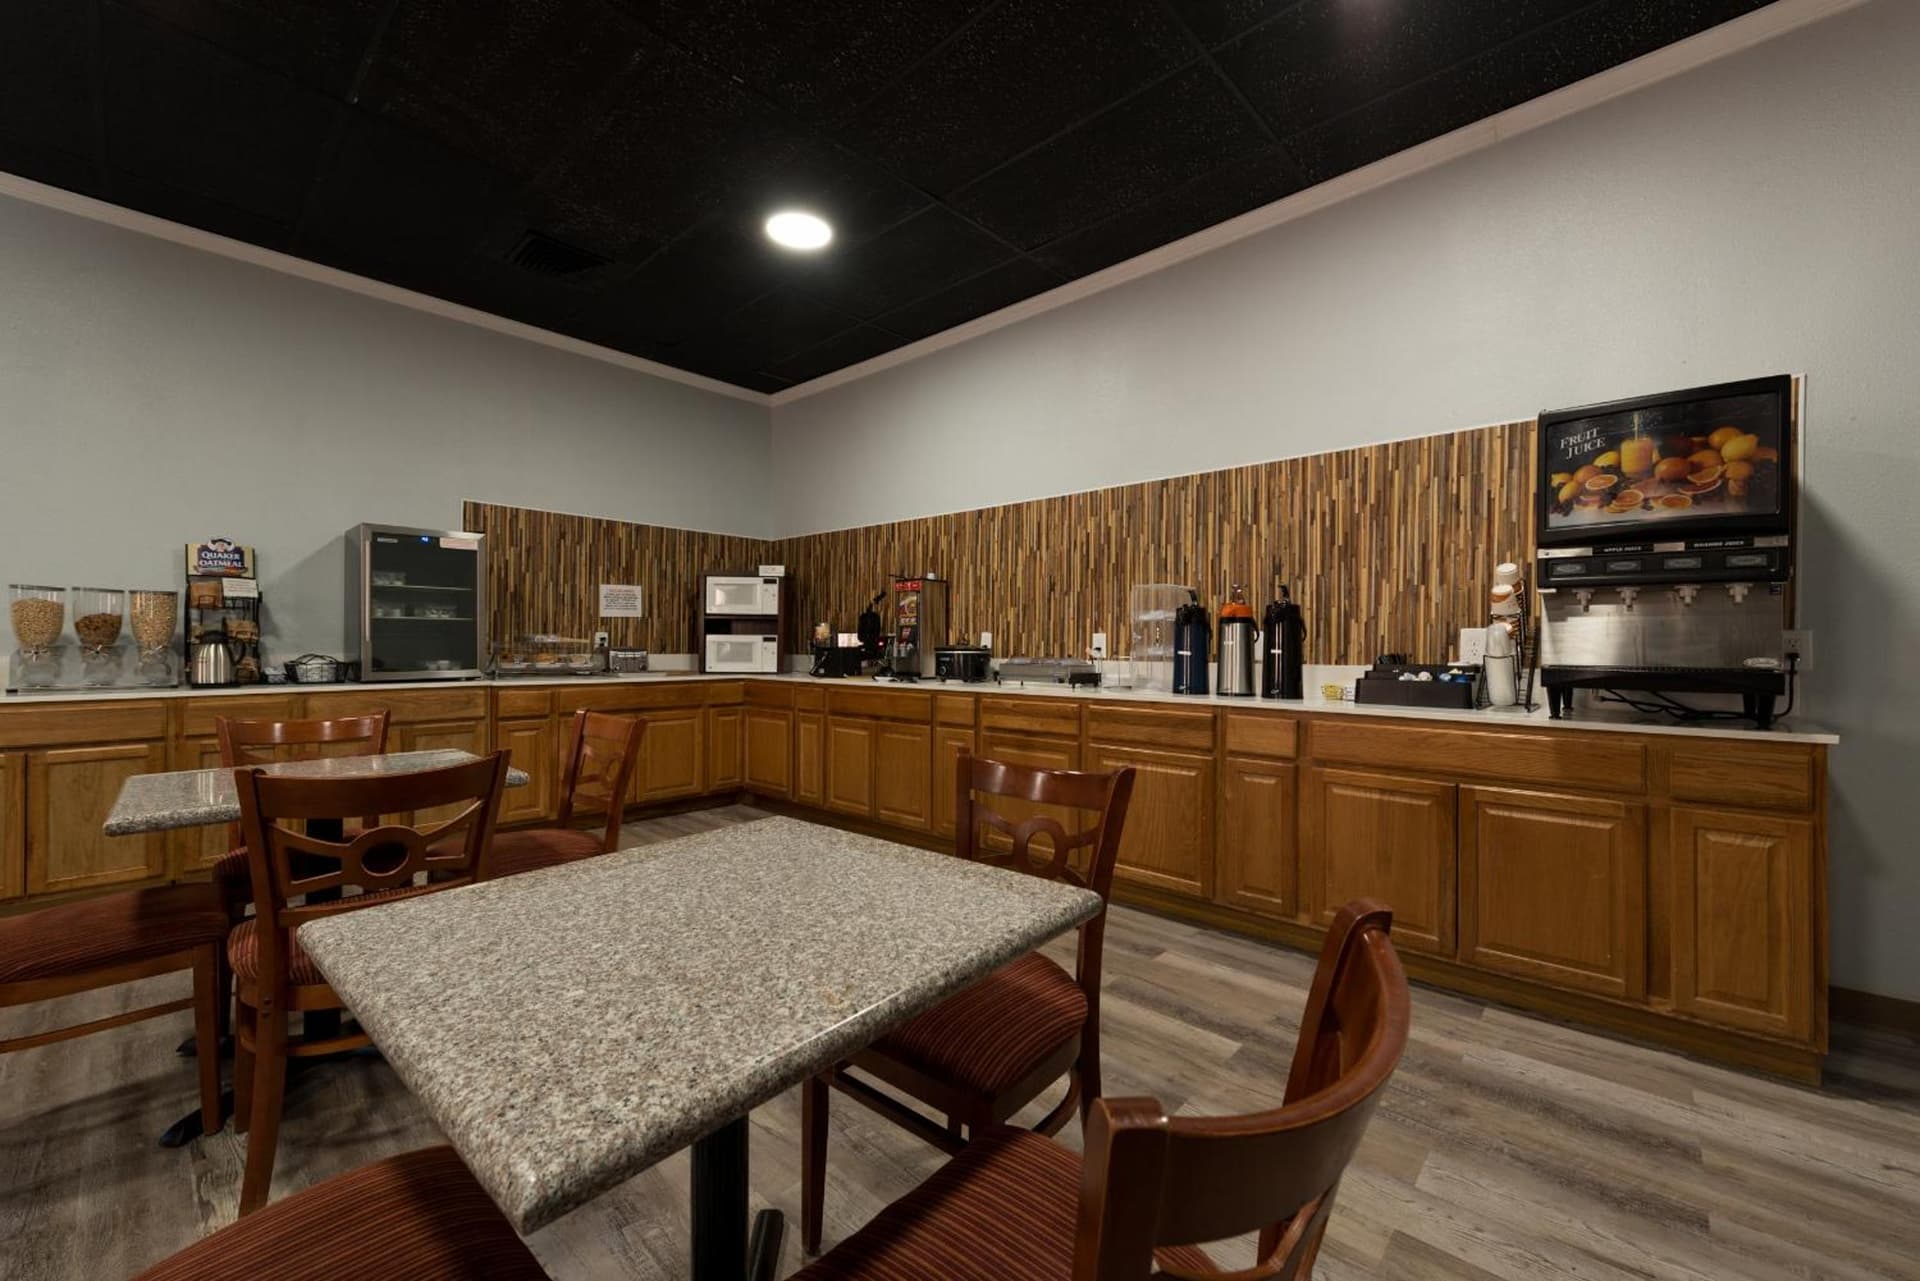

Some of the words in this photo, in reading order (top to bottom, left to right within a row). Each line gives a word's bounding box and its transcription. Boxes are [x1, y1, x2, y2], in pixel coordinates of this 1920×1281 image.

[1560, 427, 1599, 448] FRUIT
[1566, 437, 1605, 459] JUICE
[202, 551, 240, 560] QUAKER
